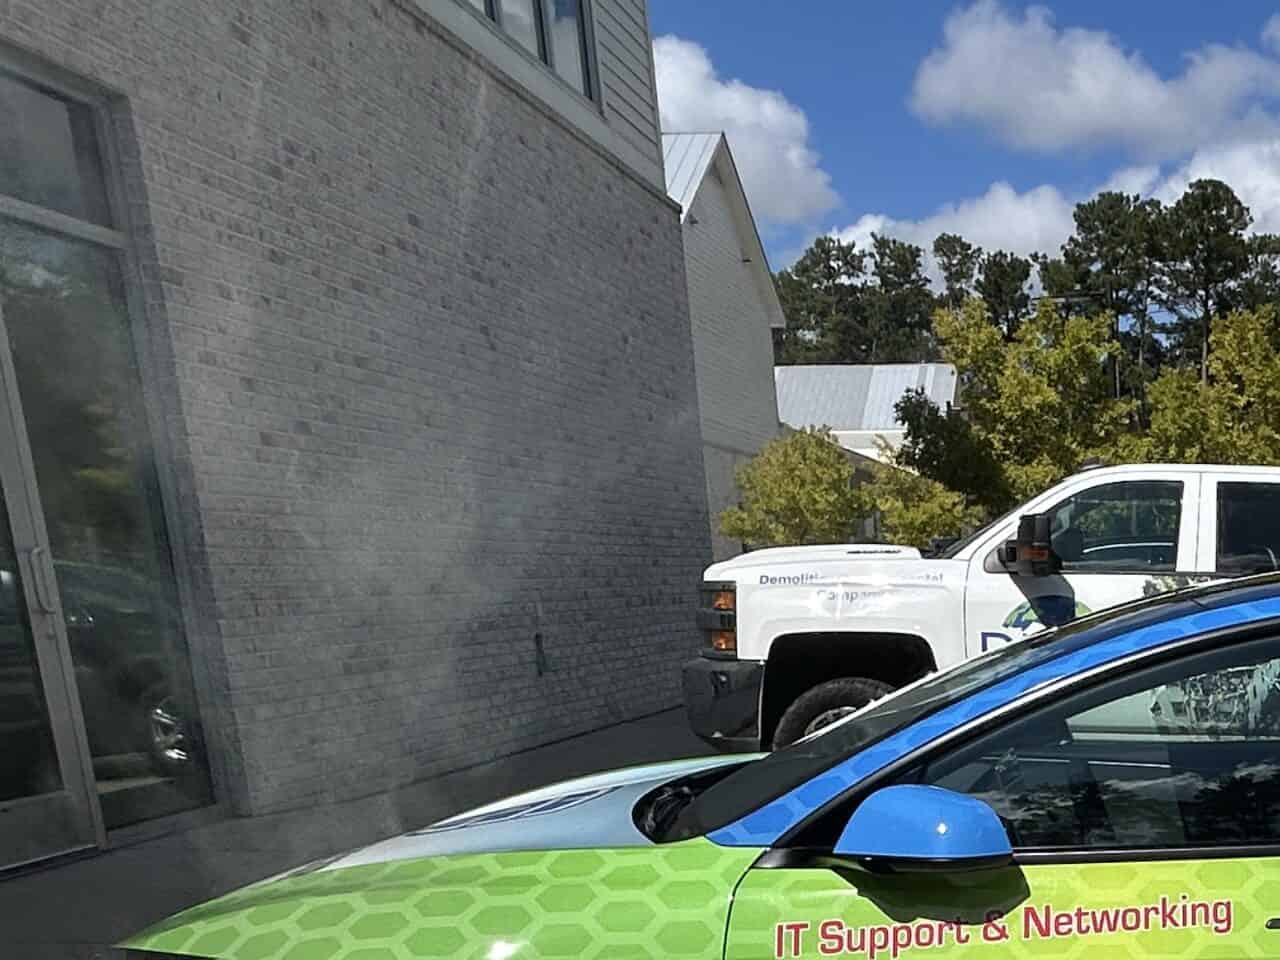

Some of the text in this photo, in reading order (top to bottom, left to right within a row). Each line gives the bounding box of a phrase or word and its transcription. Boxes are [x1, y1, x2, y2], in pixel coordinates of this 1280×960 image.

[775, 895, 1232, 960] IT Support & Networking
